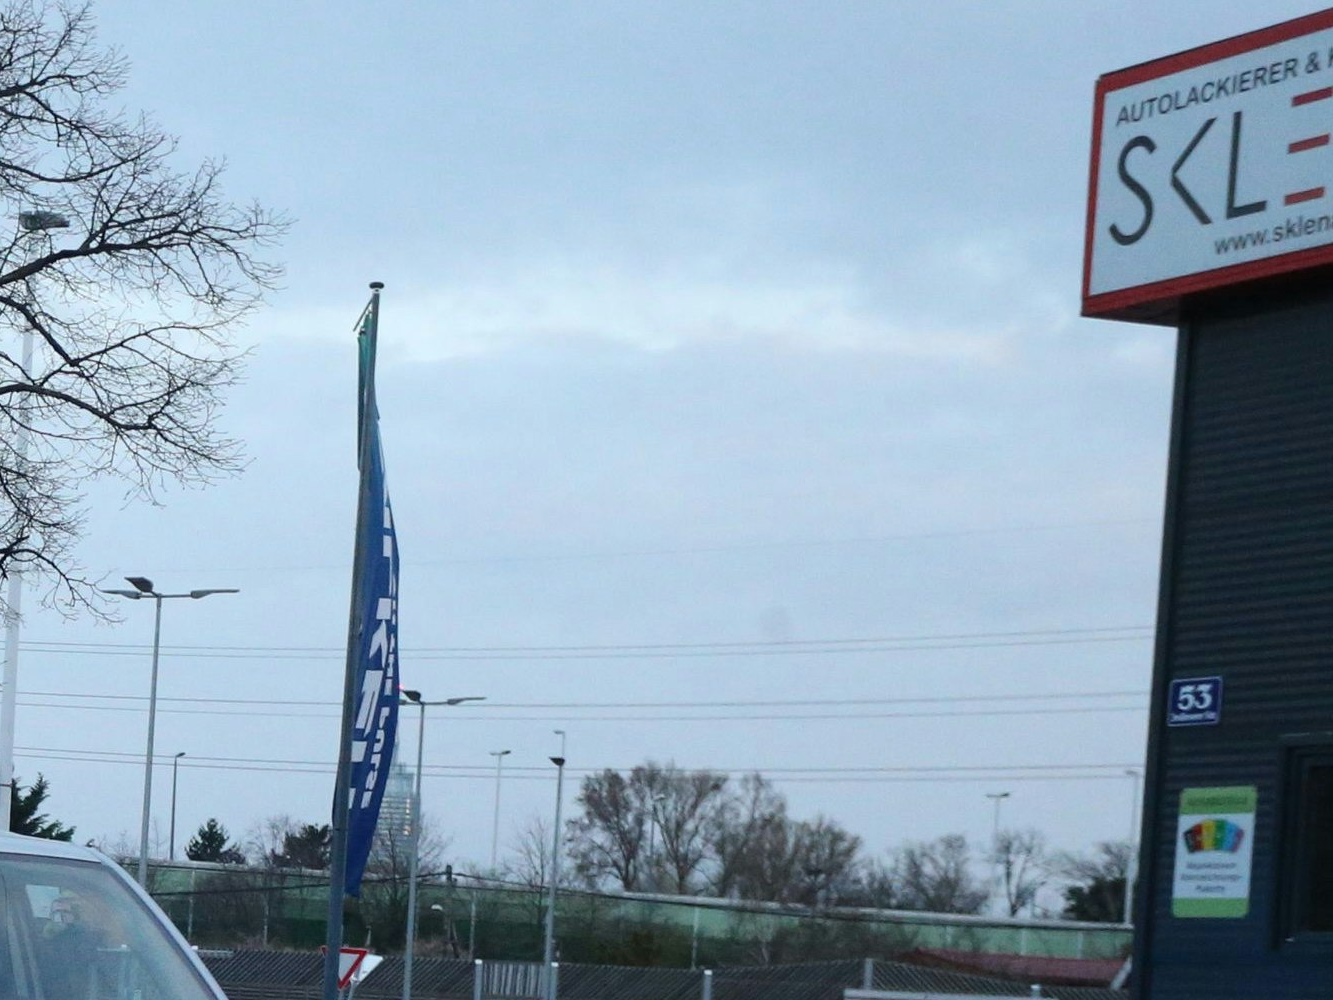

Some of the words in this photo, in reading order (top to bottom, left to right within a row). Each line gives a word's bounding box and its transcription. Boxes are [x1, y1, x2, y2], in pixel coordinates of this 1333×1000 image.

[1115, 57, 1299, 127] AUTOLACKIERER
[1304, 51, 1322, 74] &
[1177, 683, 1213, 710] 53
